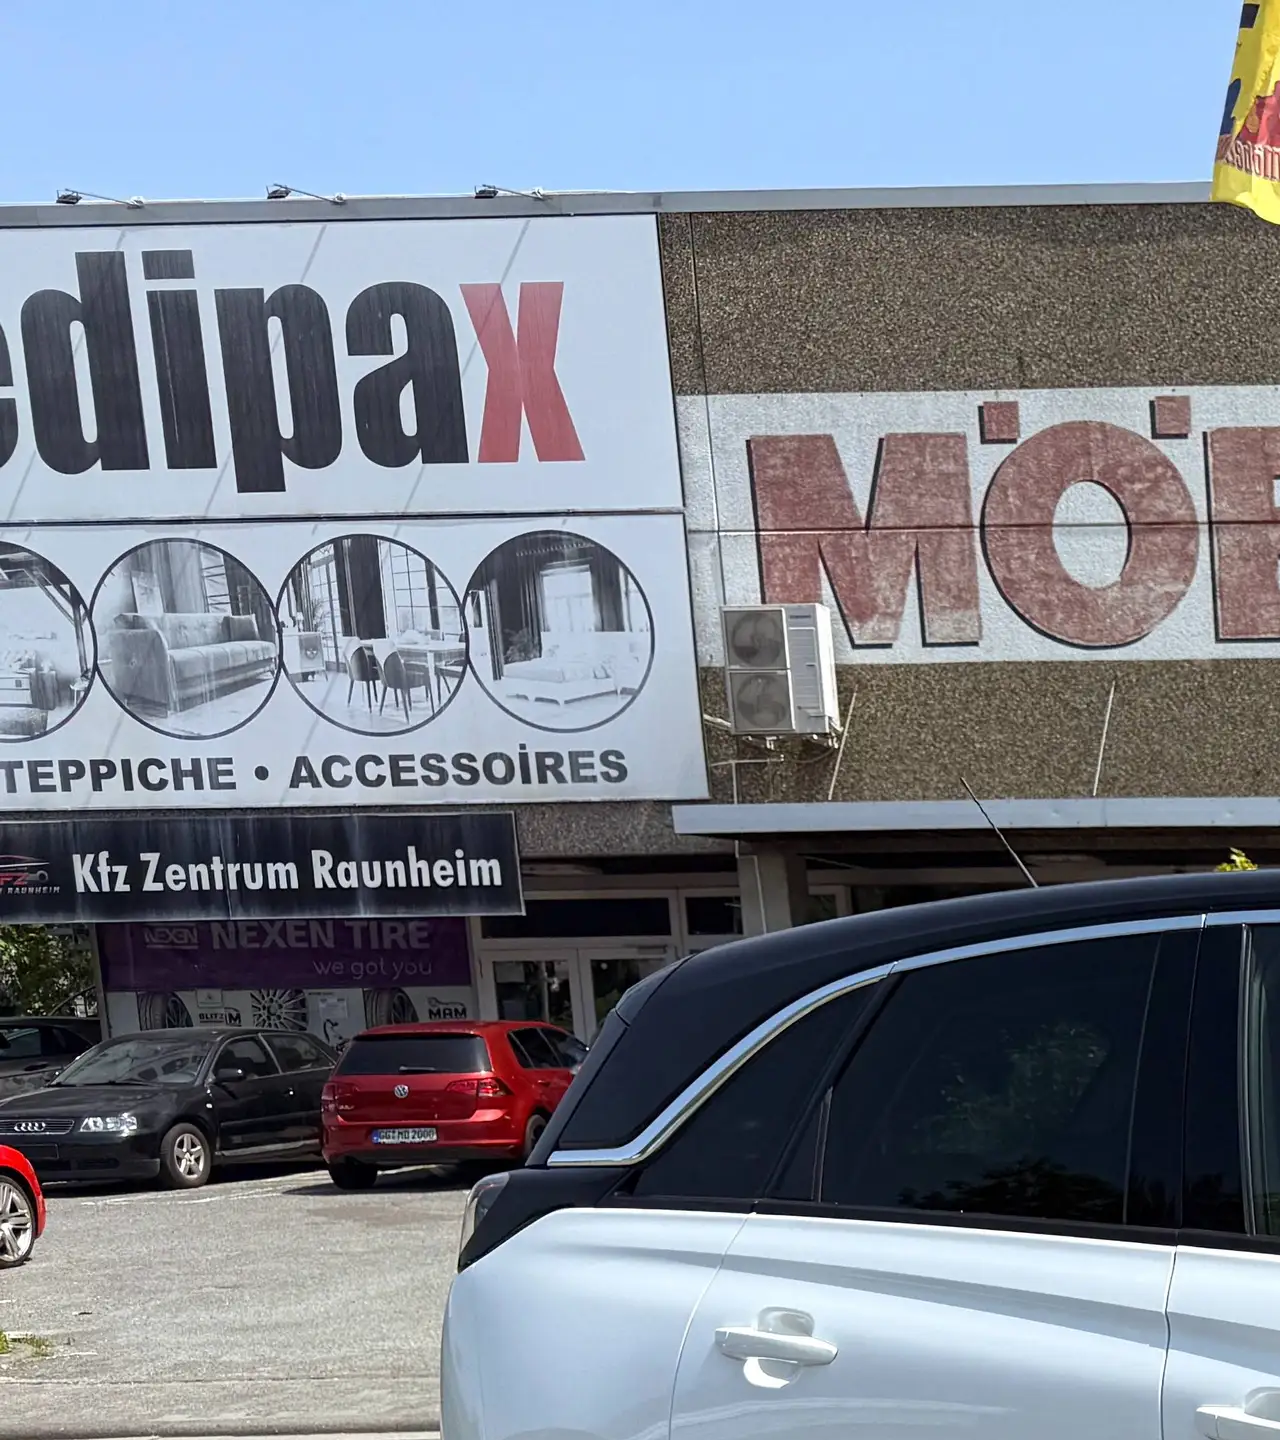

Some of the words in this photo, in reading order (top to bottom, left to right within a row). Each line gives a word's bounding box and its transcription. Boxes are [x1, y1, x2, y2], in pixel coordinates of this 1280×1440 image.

[0, 249, 586, 493] dipax
[0, 756, 237, 794] TEPPICHE
[73, 850, 130, 893] Kfz
[139, 851, 299, 892] Zentrum
[311, 845, 503, 890] Raunheim
[210, 920, 335, 950] NEXEN
[345, 919, 431, 949] TIRE
[313, 960, 345, 976] we
[351, 957, 387, 979] got
[392, 961, 432, 980] you
